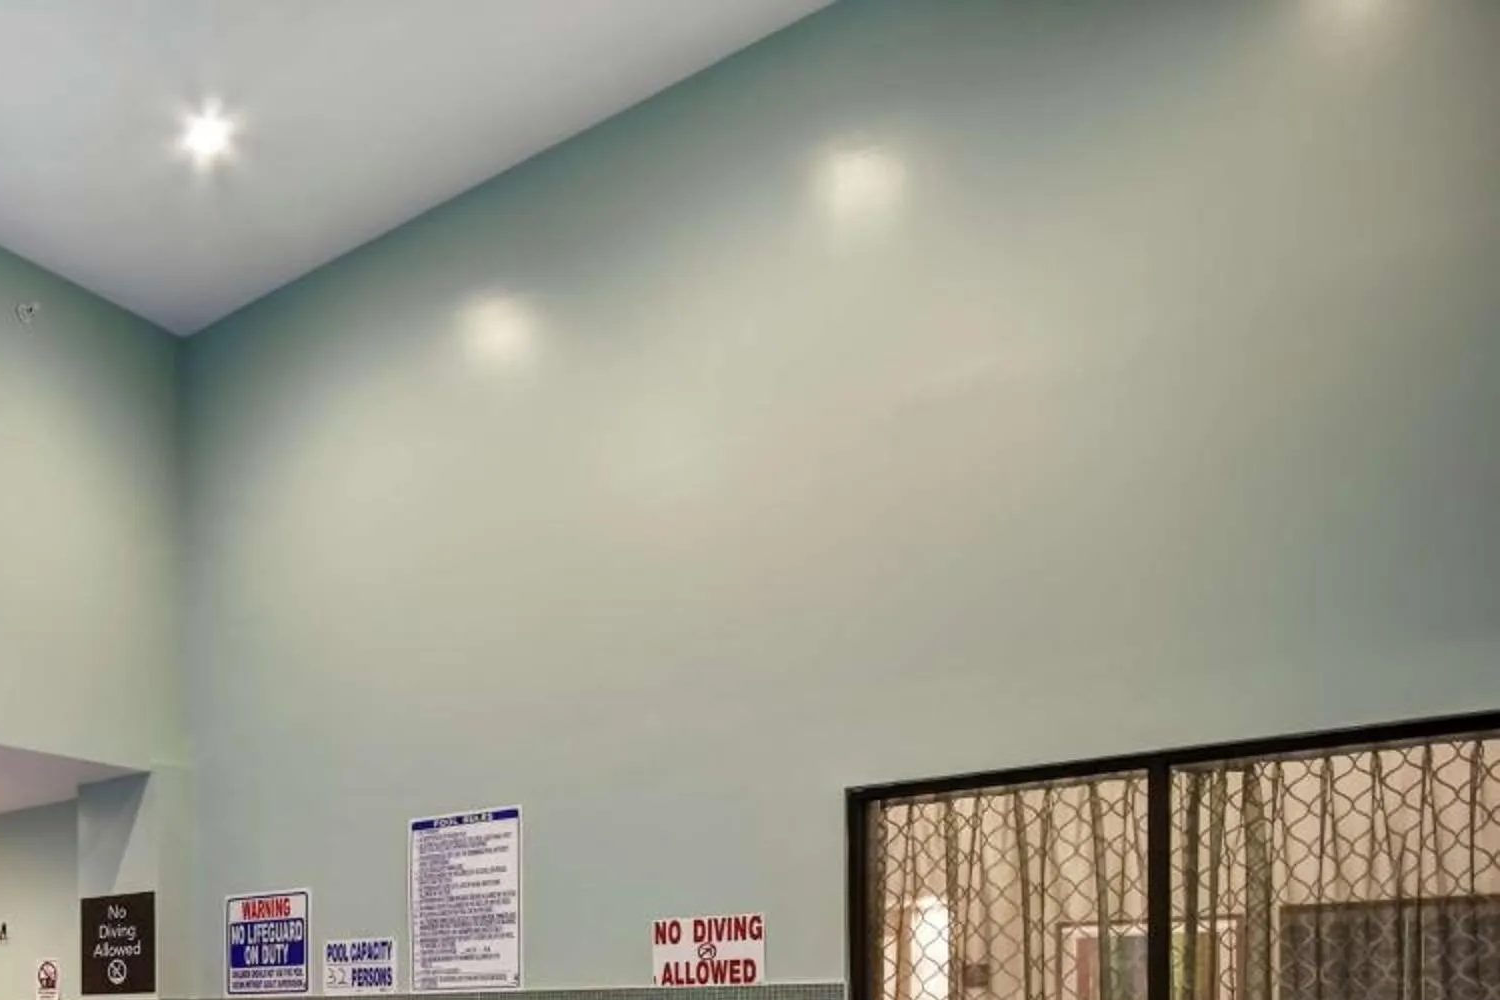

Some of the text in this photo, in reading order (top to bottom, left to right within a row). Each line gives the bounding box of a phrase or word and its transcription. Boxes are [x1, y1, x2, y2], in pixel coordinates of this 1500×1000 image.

[107, 904, 127, 919] No
[241, 897, 291, 920] WARNING
[98, 924, 137, 941] Diving
[231, 920, 303, 945] NO LIFEGUARD
[654, 915, 763, 944] NO DIVING
[93, 940, 141, 958] Allowed
[244, 944, 289, 965] ON DUTY
[326, 940, 393, 963] POOL CAPACITY
[326, 967, 349, 985] 32
[351, 966, 393, 987] PERSONS
[661, 958, 757, 985] ALLOWED
